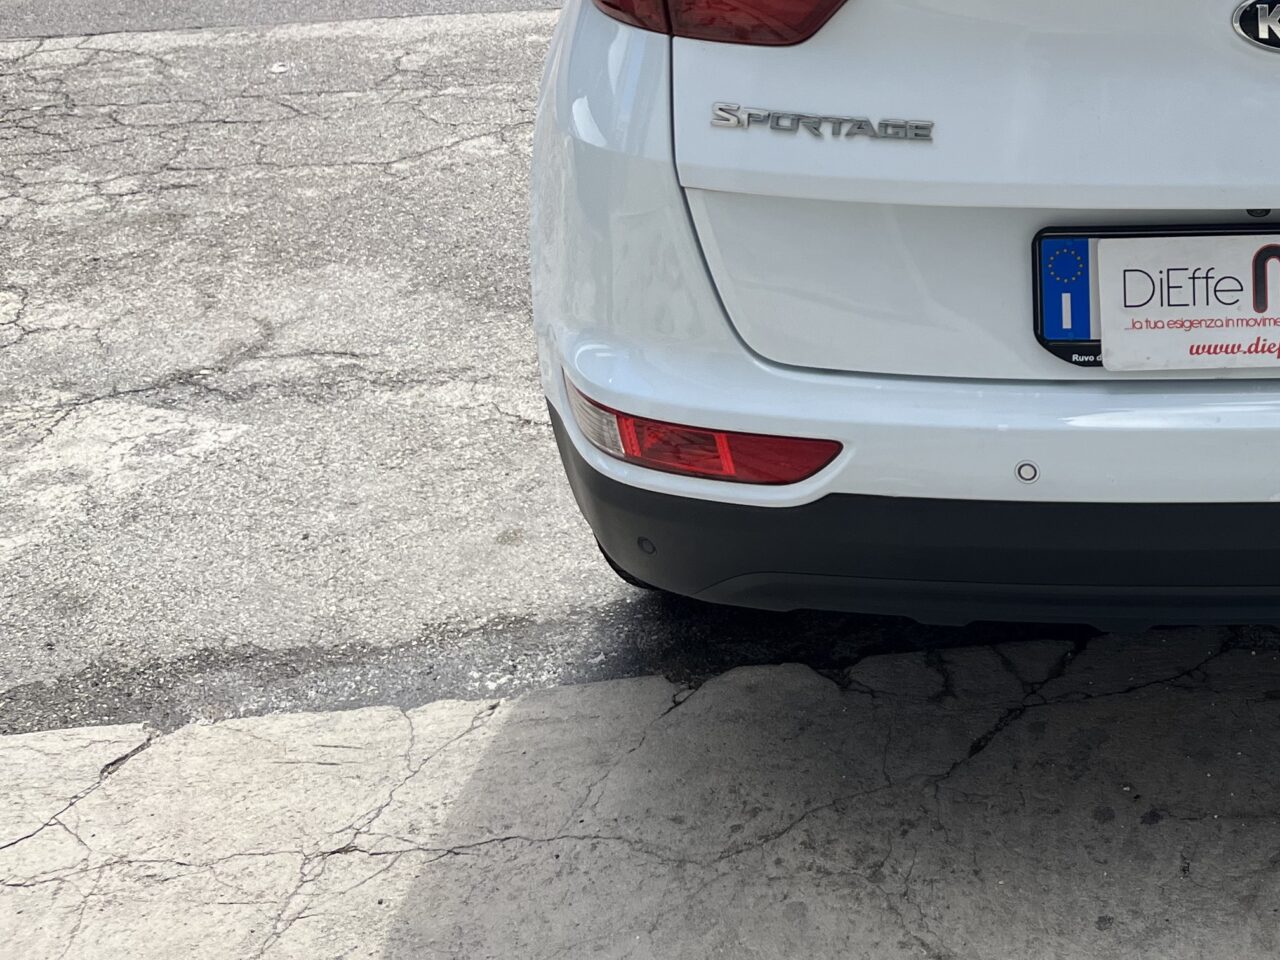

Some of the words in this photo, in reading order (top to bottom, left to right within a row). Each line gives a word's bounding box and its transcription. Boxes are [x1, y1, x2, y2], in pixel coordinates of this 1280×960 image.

[1122, 267, 1244, 308] DiEffe
[1145, 318, 1165, 331] tua
[1167, 317, 1224, 332] esigenza
[1225, 316, 1235, 328] in
[1072, 354, 1095, 362] Ruvo
